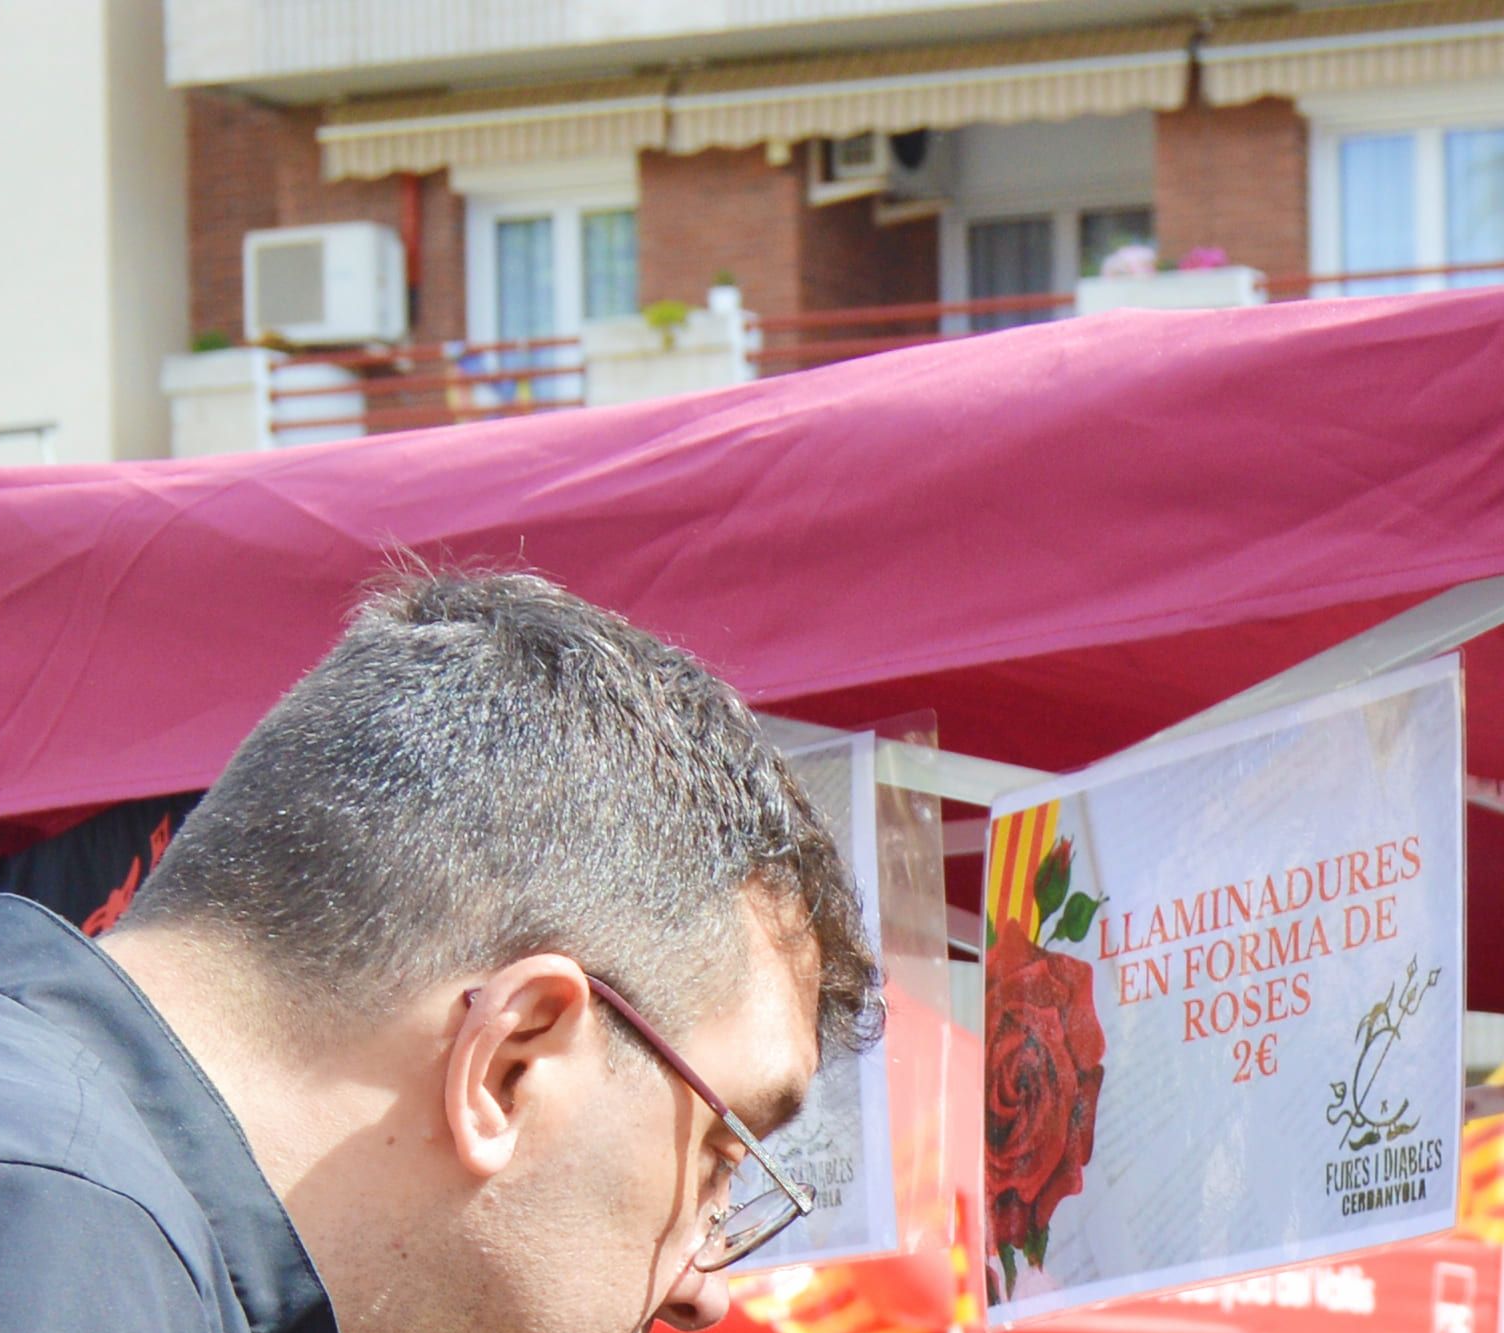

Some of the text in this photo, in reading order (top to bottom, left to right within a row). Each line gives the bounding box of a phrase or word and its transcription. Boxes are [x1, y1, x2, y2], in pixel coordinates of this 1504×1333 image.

[1098, 836, 1422, 960] LLAMINADURES
[1119, 895, 1399, 1006] EN FORMA DE
[1183, 972, 1312, 1042] ROSES
[1231, 1033, 1279, 1083] 2€
[1325, 1152, 1371, 1195] FURES
[1383, 1138, 1444, 1183] DIABLES
[1341, 1178, 1428, 1217] CERDANYOLA
